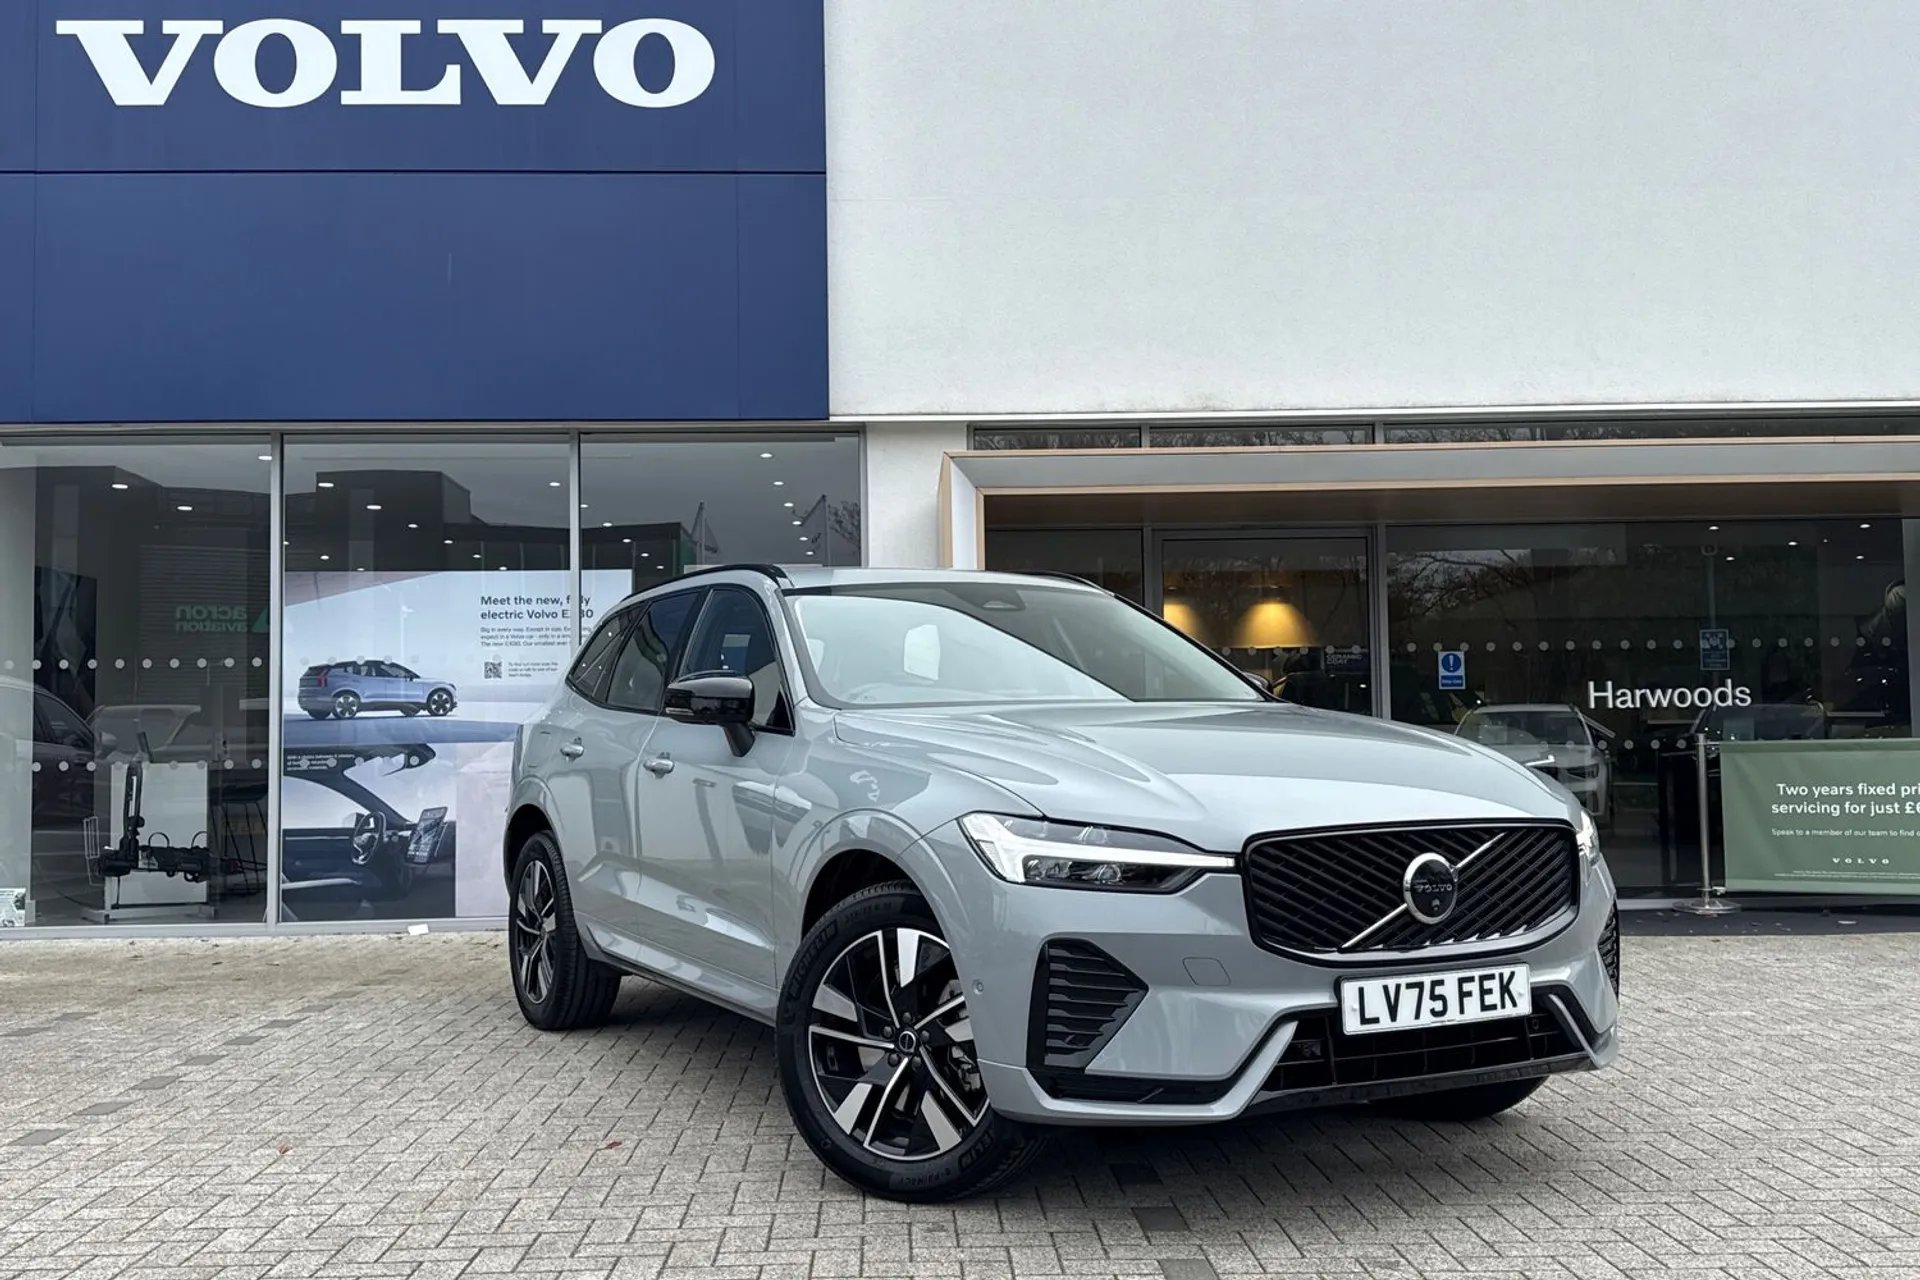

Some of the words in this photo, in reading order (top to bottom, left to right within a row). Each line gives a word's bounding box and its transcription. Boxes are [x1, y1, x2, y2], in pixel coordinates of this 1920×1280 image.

[56, 18, 715, 108] VOLVO
[481, 595, 511, 606] Meet
[514, 595, 533, 606] the
[536, 595, 563, 606] new,
[566, 594, 591, 606] fly
[481, 609, 524, 619] electric
[526, 609, 558, 619] Volvo
[1587, 679, 1752, 709] Harwoods
[1776, 783, 1808, 795] Two
[1812, 785, 1854, 798] years
[1858, 782, 1896, 795] fixed
[1771, 801, 1840, 817] servicing
[1844, 801, 1866, 814] for
[1870, 801, 1900, 817] just
[1771, 828, 1795, 837] Speak
[1890, 829, 1898, 837] to
[1899, 829, 1915, 837] find
[1414, 883, 1453, 893] VOLVO
[1357, 979, 1448, 1026] LV75
[1457, 971, 1518, 1015] FEK
